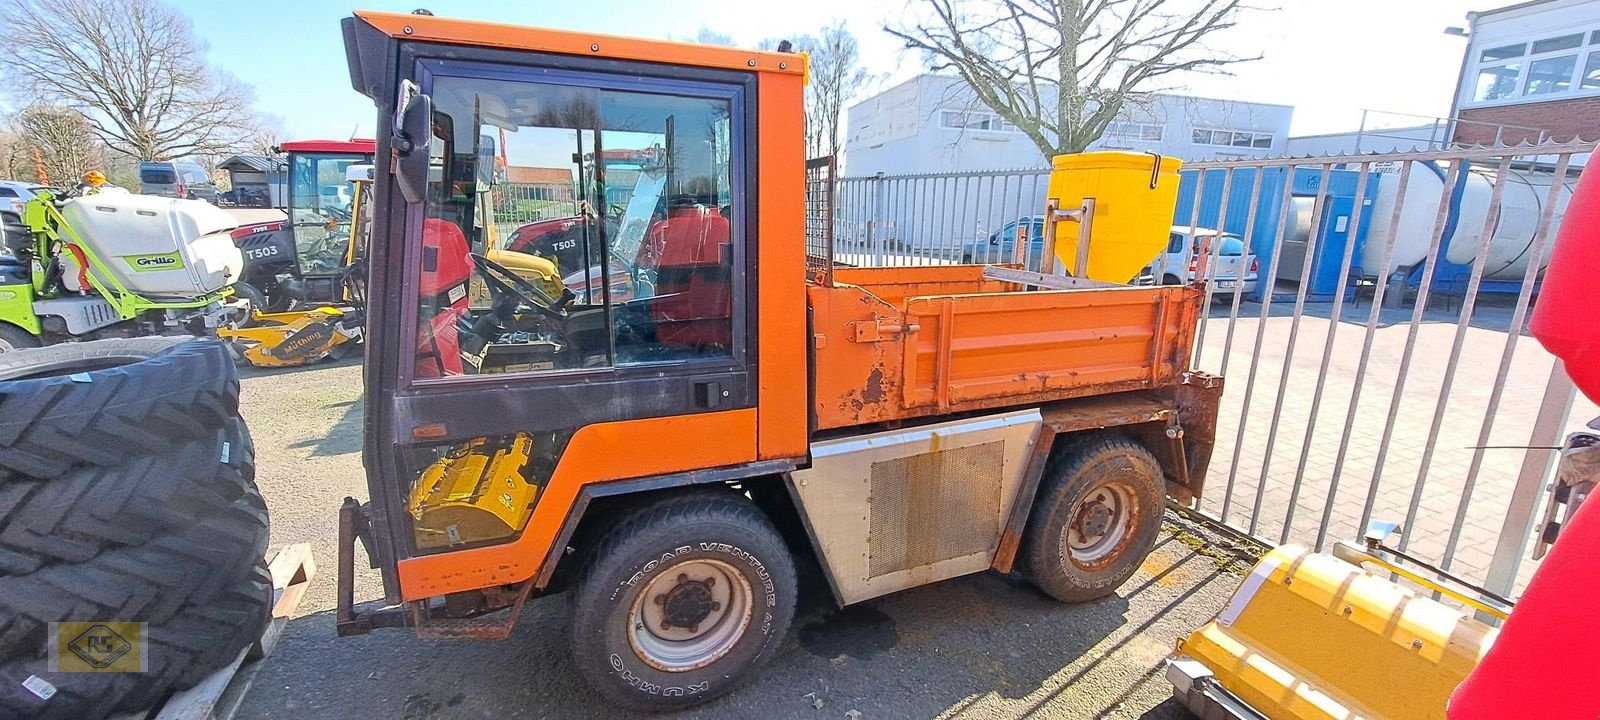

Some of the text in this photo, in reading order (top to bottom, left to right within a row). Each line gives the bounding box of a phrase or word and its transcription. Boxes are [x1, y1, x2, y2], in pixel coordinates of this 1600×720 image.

[246, 245, 278, 260] T503
[552, 239, 576, 252] T503
[136, 257, 176, 266] Grillo
[627, 545, 691, 587] ROAD
[700, 542, 776, 608] VENTURE
[609, 653, 709, 697] KUMHO
